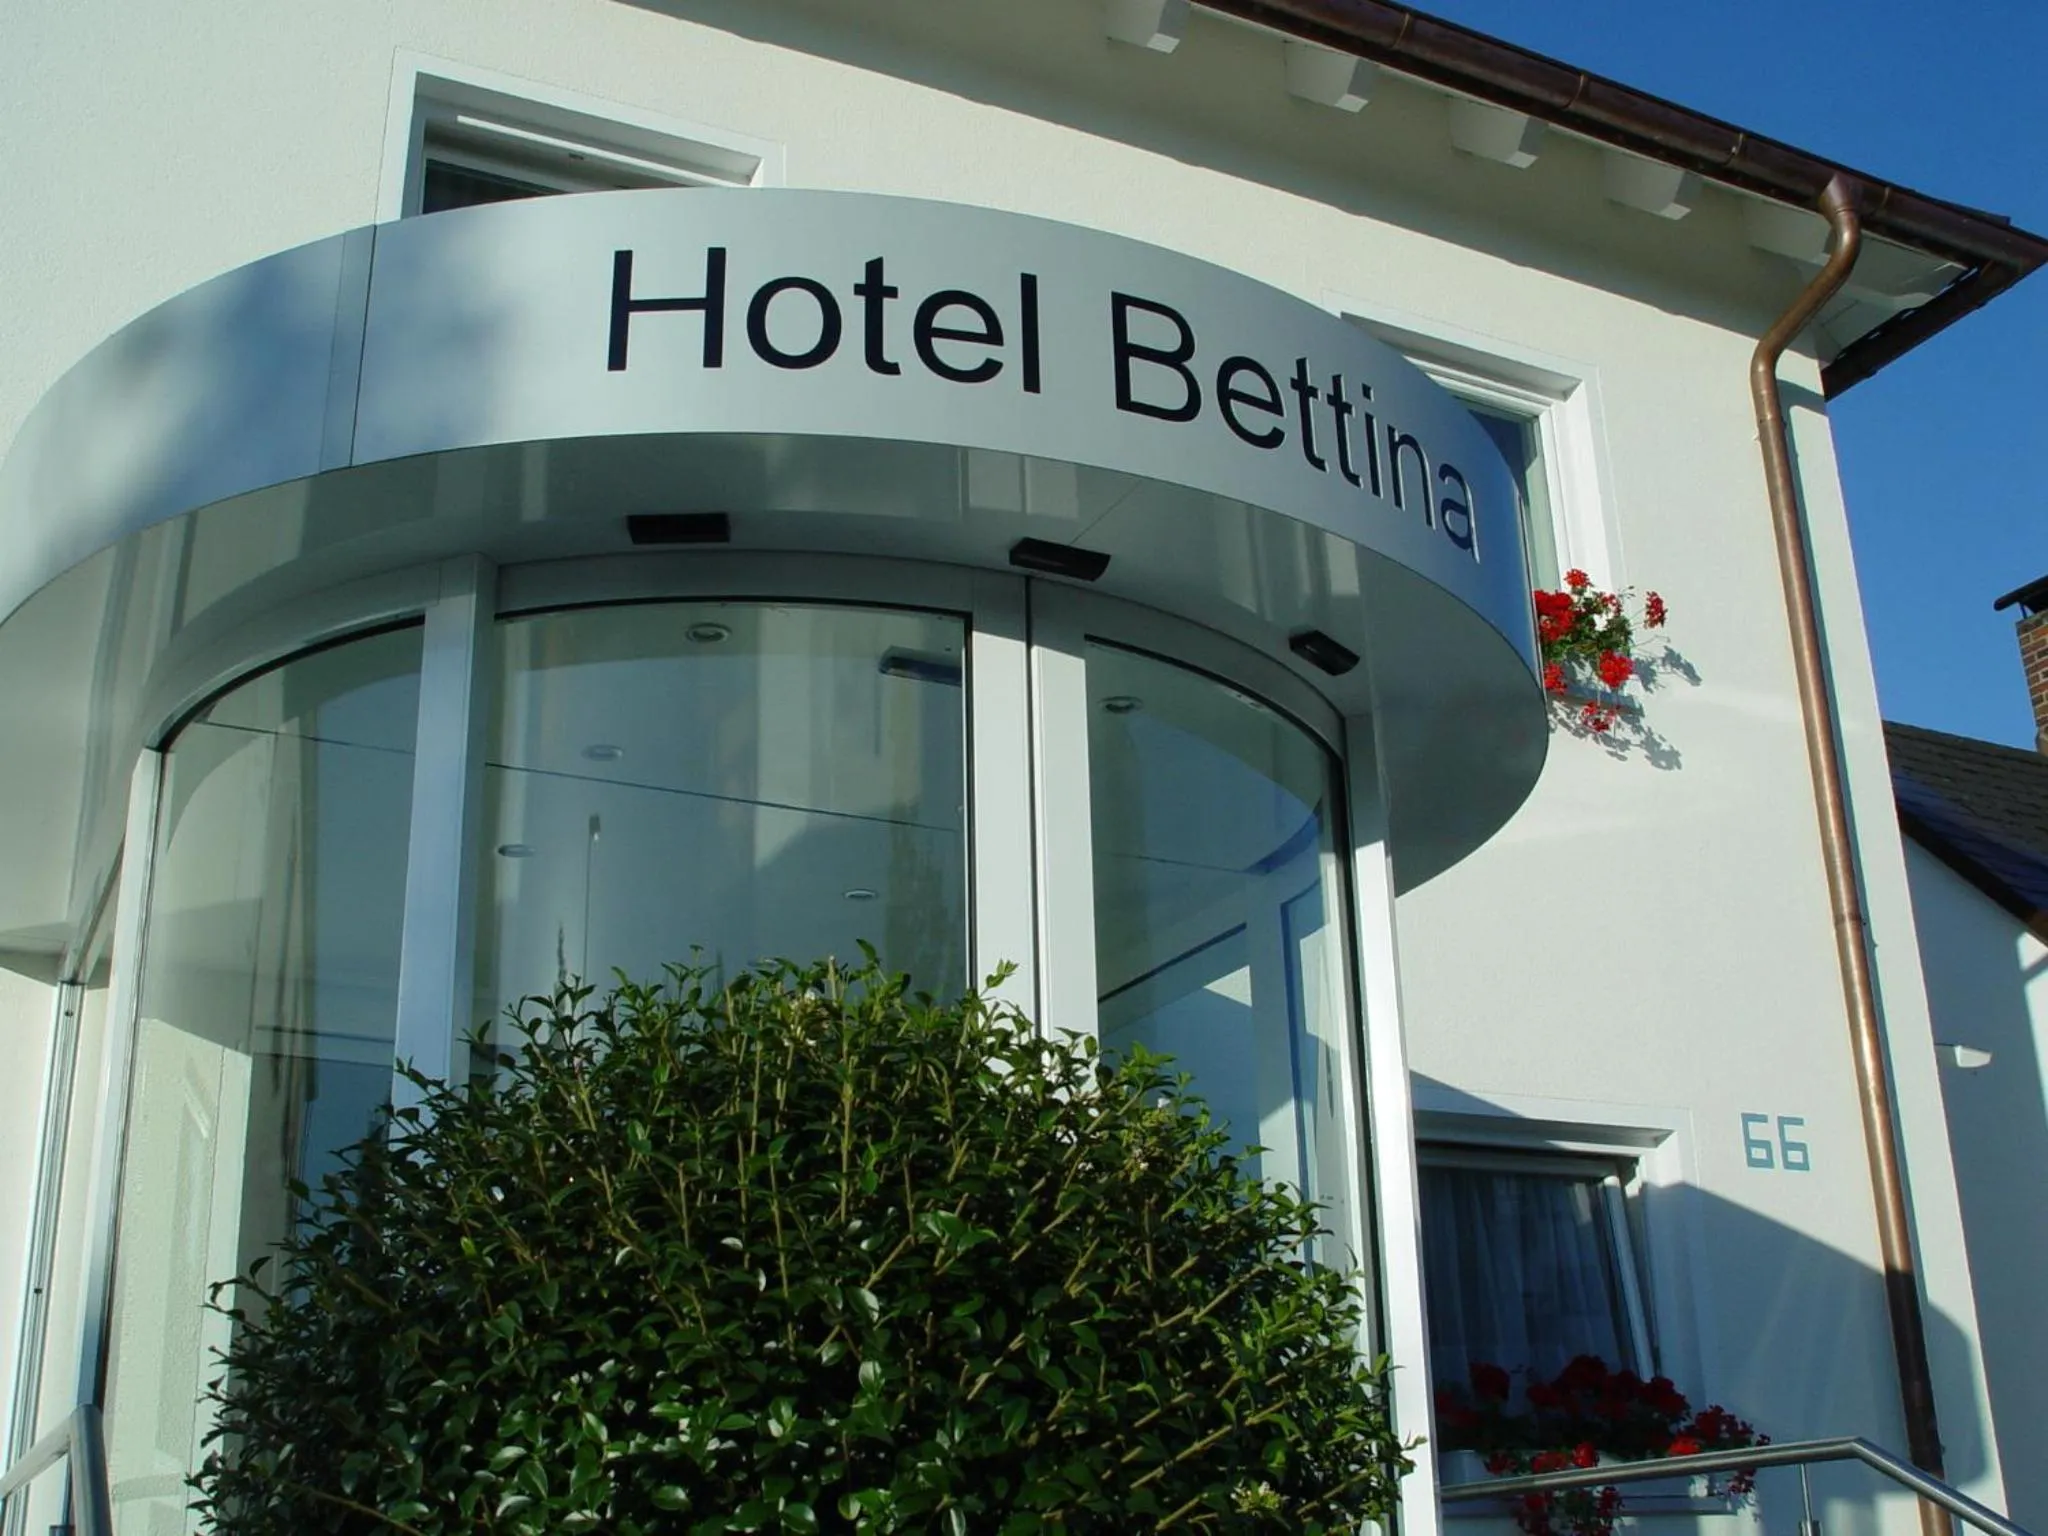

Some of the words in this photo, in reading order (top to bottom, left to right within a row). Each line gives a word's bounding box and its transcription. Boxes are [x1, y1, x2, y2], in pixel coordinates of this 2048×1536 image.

[608, 246, 1041, 394] Hotel
[1111, 291, 1481, 564] Bettina
[1741, 1112, 1810, 1171] 66
